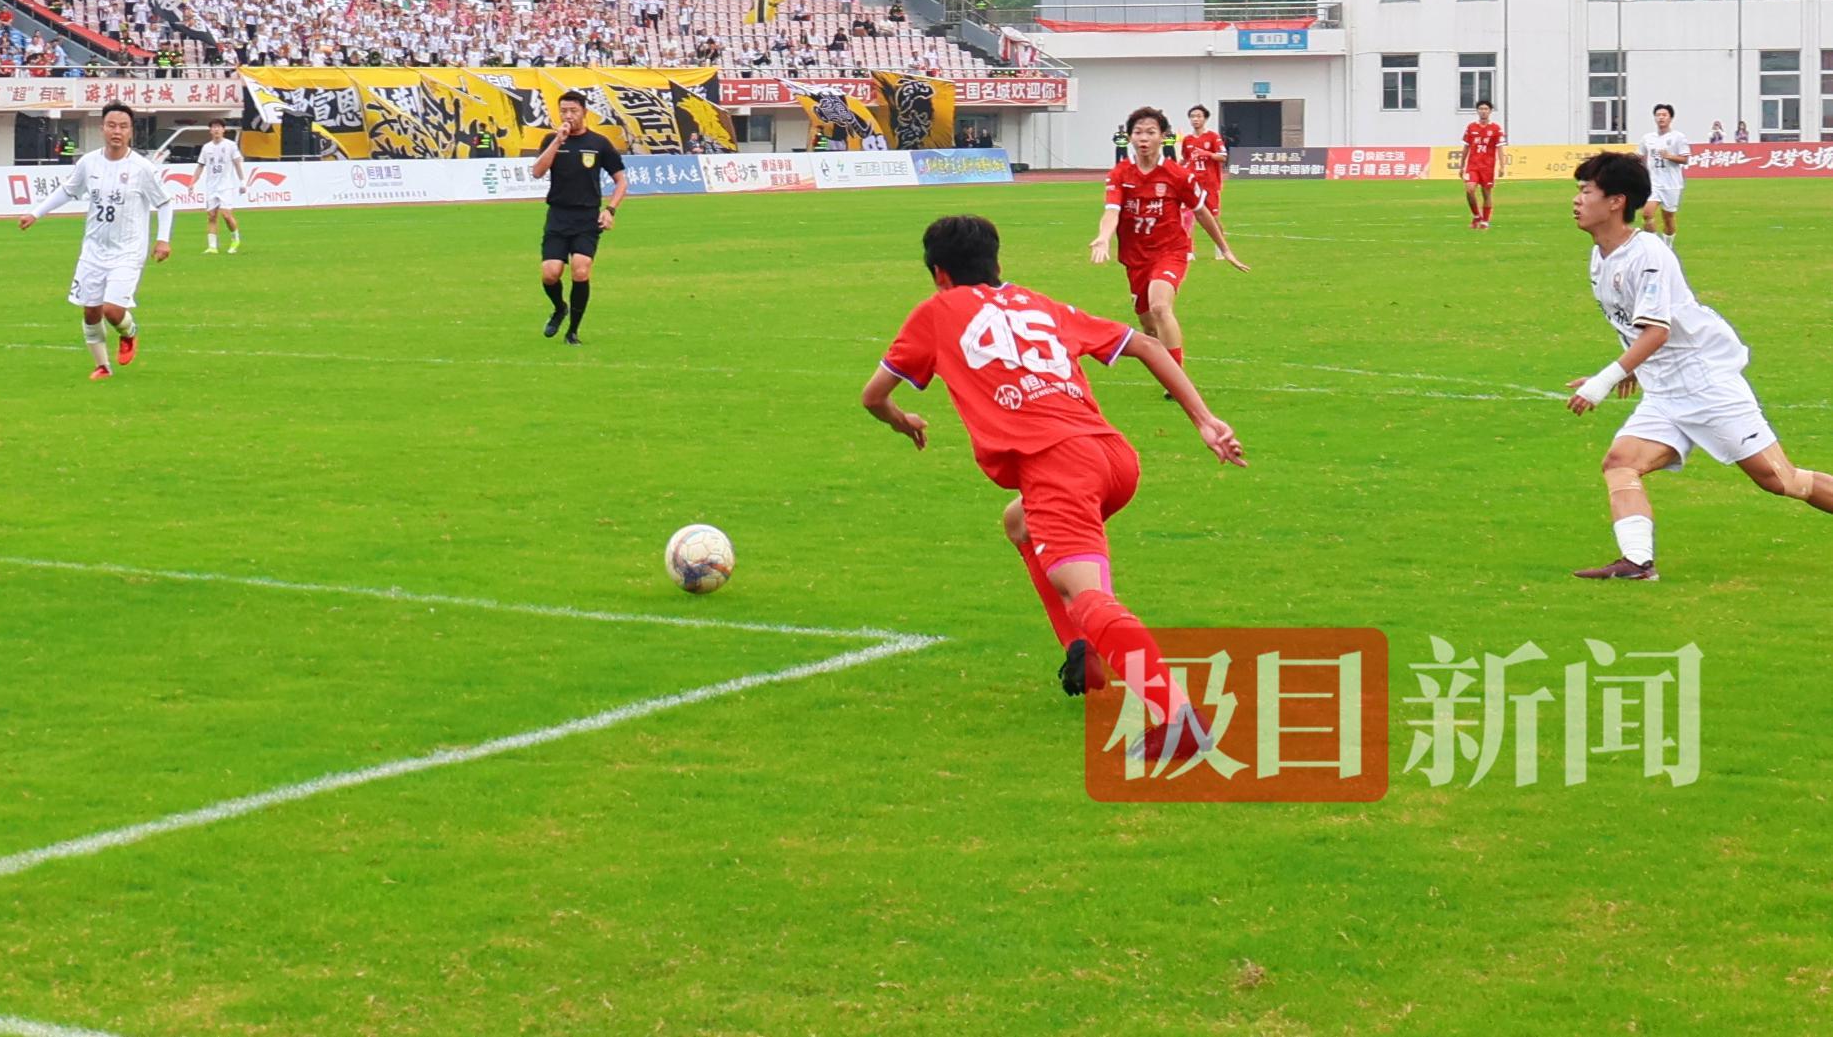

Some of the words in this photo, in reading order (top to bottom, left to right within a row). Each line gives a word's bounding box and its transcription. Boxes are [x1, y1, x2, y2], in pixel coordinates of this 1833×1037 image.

[186, 83, 244, 104] 品荆风
[247, 190, 292, 203] LI-NING
[95, 205, 116, 222] 28
[1134, 217, 1157, 234] 77
[959, 302, 1073, 381] 45
